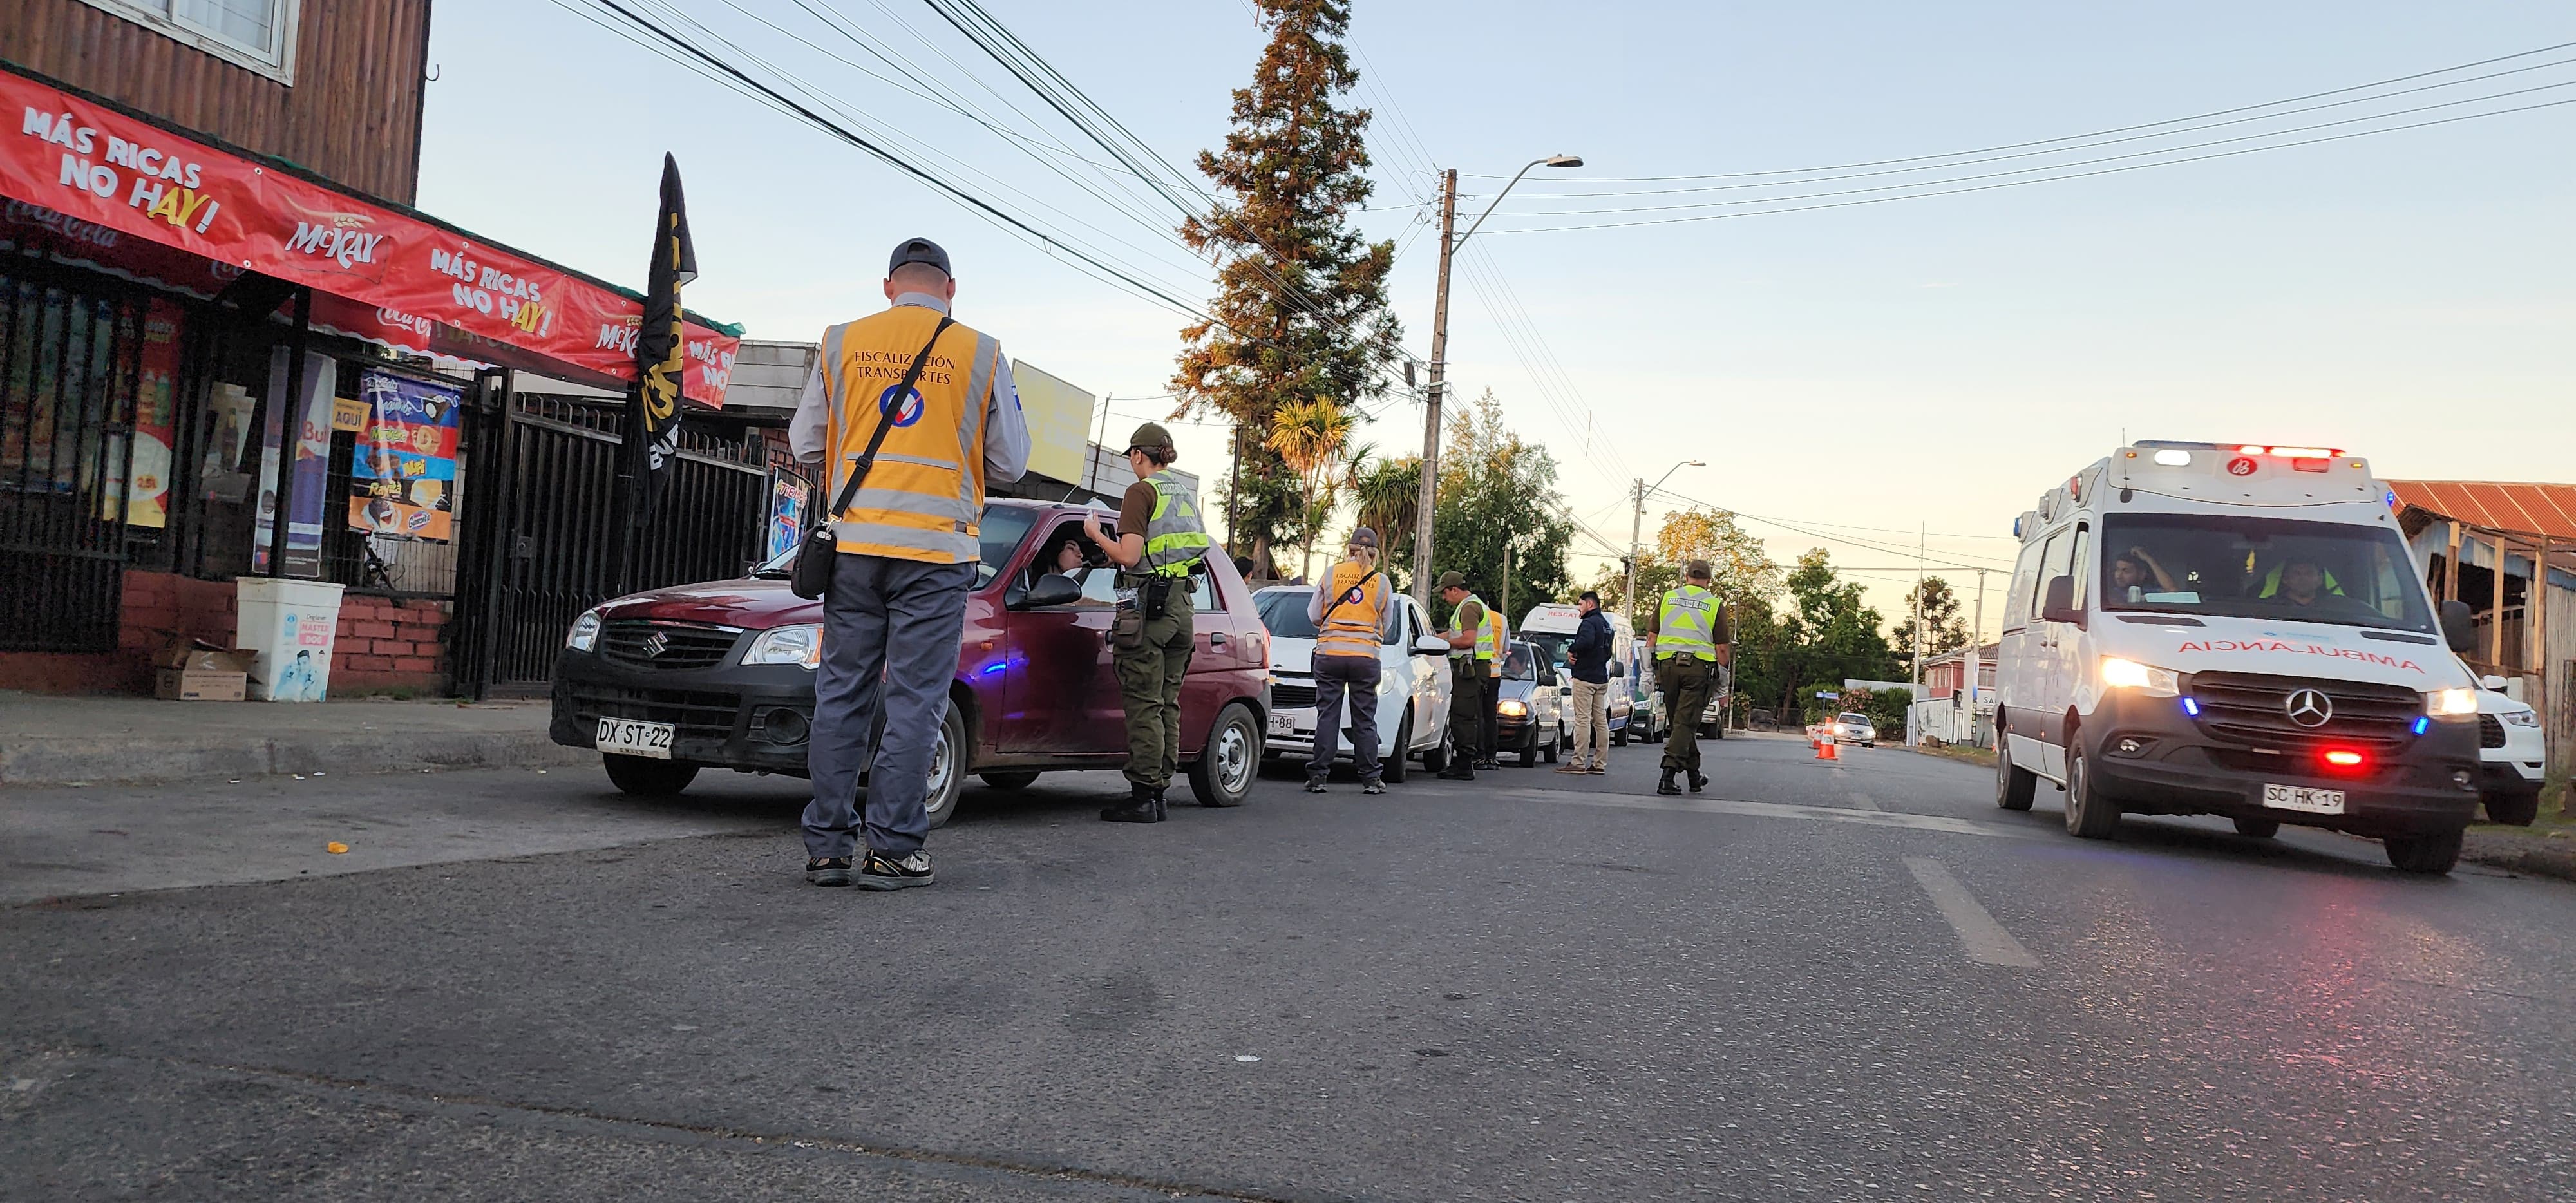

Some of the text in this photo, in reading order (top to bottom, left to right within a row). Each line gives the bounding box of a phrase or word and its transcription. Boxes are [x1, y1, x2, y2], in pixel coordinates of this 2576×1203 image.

[23, 106, 201, 189] MÁS RICAS
[60, 154, 220, 234] NO HAY!
[431, 249, 541, 302] MÁS RICAS
[453, 283, 492, 314] NO
[500, 296, 553, 337] HAY!
[596, 324, 641, 359] McK
[689, 340, 719, 365] MÁS
[703, 365, 728, 391] NO
[855, 351, 955, 370] FISCALIZCIÓN
[857, 366, 951, 384] TRANSPRTES
